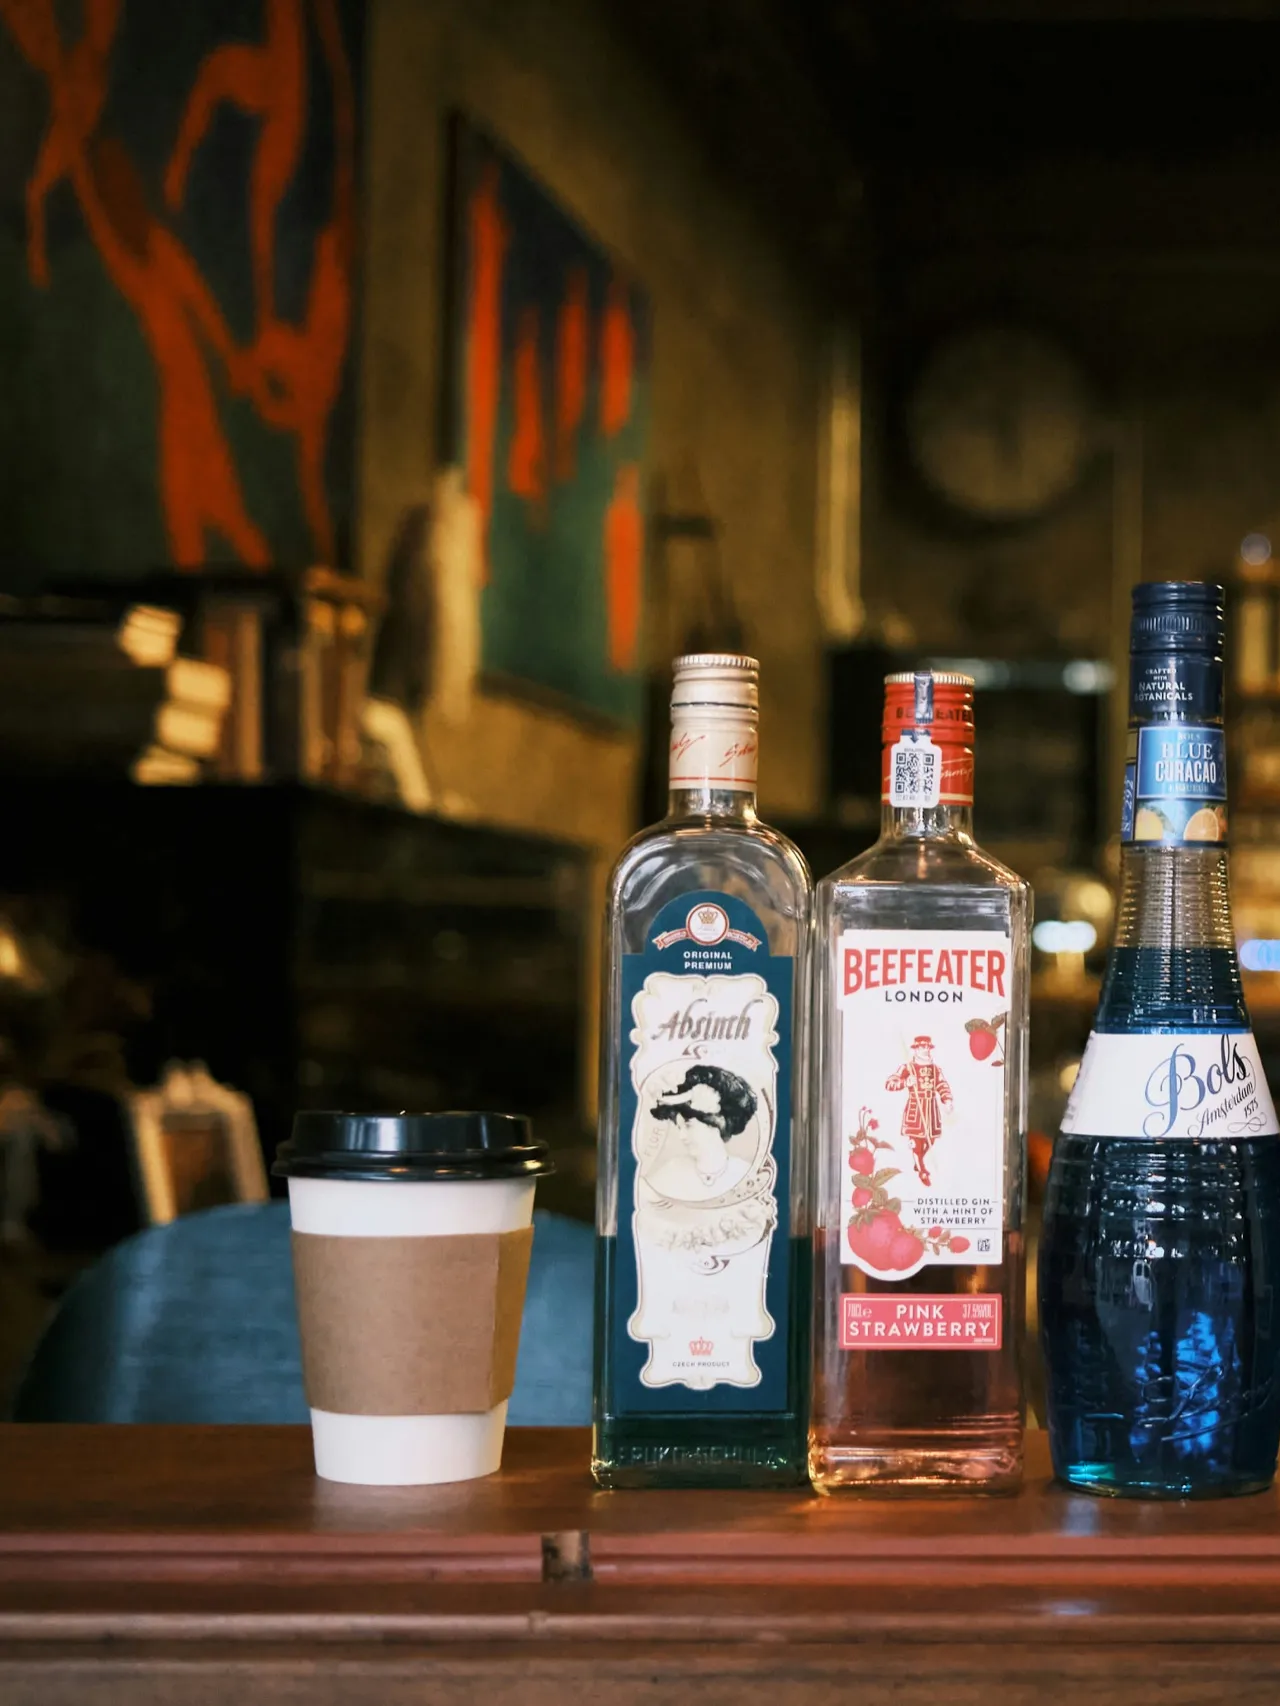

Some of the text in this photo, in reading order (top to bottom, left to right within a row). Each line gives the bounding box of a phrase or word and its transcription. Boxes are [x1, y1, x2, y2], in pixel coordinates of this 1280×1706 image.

[1161, 742, 1214, 760] BLUE
[683, 951, 733, 960] ORIGINAL
[684, 961, 733, 970] PREMIUM
[843, 948, 1006, 998] BEEFEATER
[884, 990, 963, 1003] LONDON
[650, 998, 763, 1041] Absinth
[1142, 1034, 1252, 1138] Bols
[1187, 1081, 1255, 1138] Amsterdam
[1243, 1098, 1260, 1119] 1575
[917, 1198, 990, 1206] DISTILLED GIN
[913, 1207, 938, 1215] WITH
[920, 1216, 986, 1225] STRAWBERRY
[896, 1304, 944, 1319] PINK
[849, 1321, 991, 1337] STRAWBERRY
